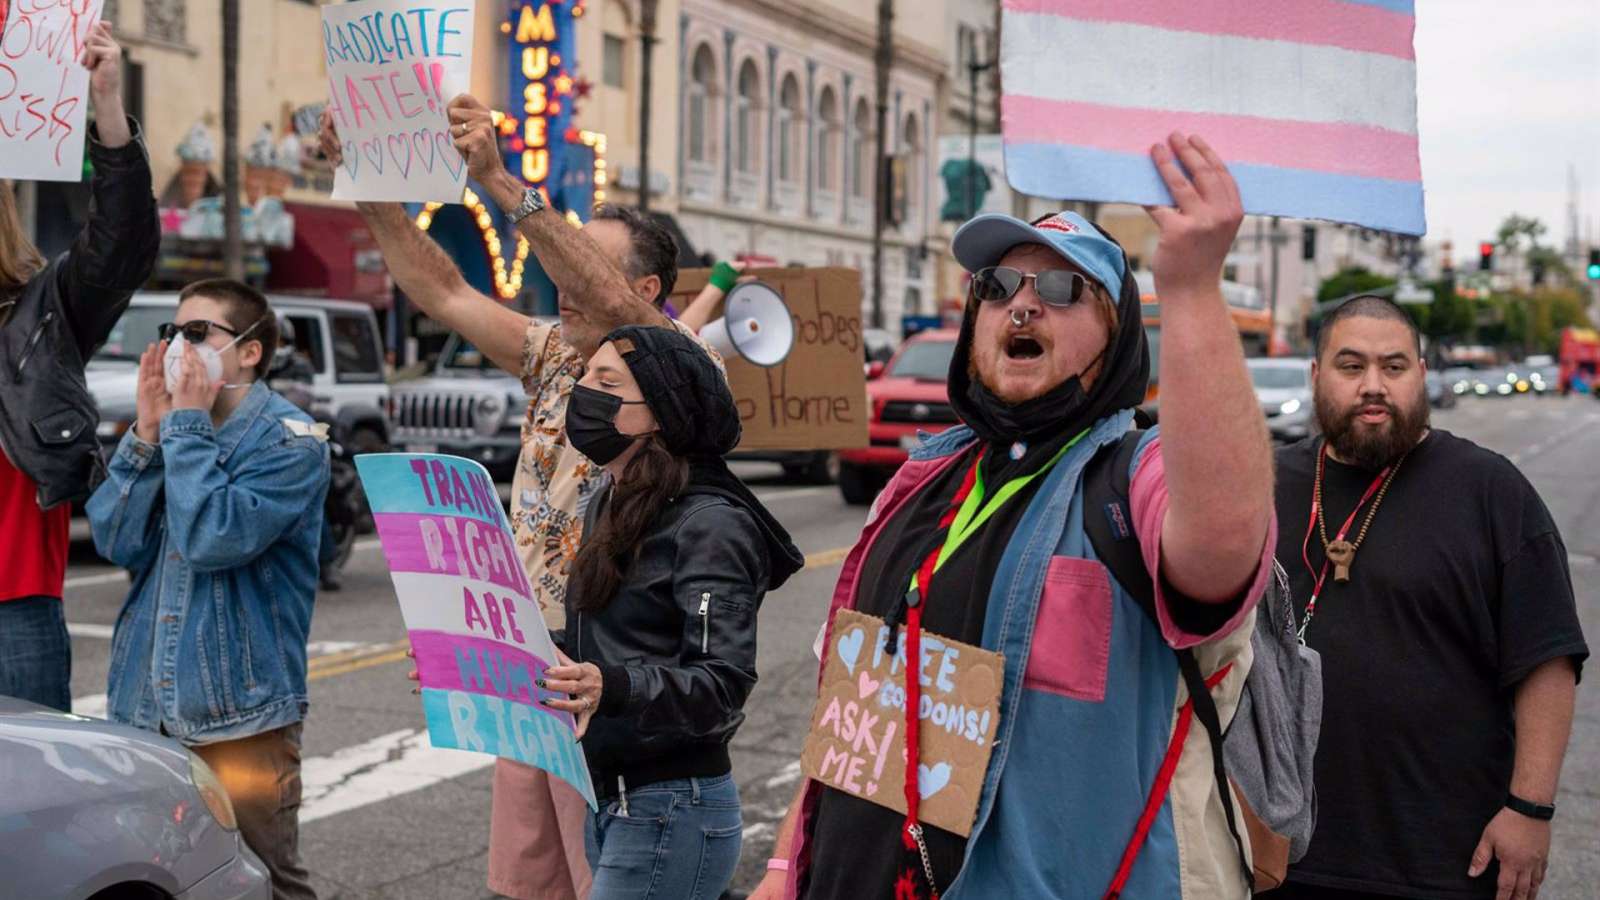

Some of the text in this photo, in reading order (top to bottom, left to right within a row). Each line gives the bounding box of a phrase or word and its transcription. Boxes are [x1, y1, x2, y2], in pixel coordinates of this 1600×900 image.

[322, 8, 470, 66] RADICATE
[515, 4, 556, 184] MUSEU
[463, 586, 526, 644] ARE
[453, 643, 562, 706] HUM
[878, 680, 991, 746] CODOMS!
